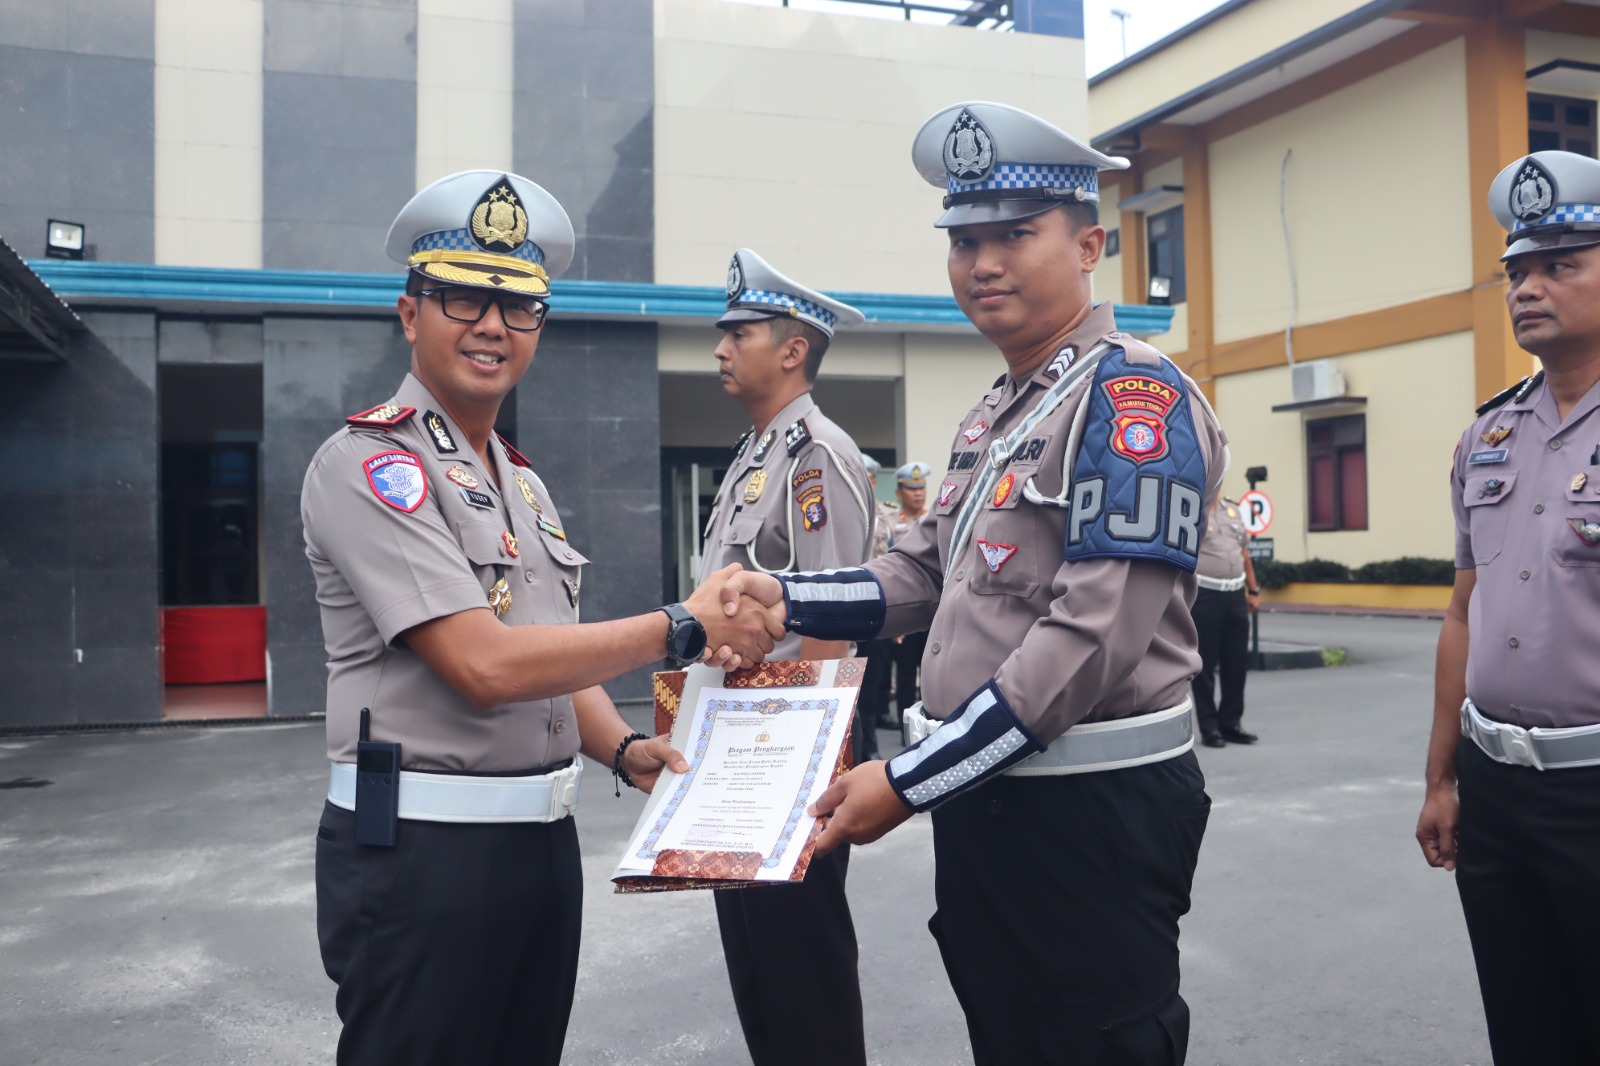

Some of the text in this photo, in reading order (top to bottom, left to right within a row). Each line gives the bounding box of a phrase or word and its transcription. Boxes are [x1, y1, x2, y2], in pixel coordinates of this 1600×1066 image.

[1112, 380, 1170, 400] POLDA
[369, 454, 417, 469] LALU LINTAS
[793, 470, 820, 487] POLDA
[1067, 474, 1201, 556] PJR
[1251, 500, 1263, 525] P
